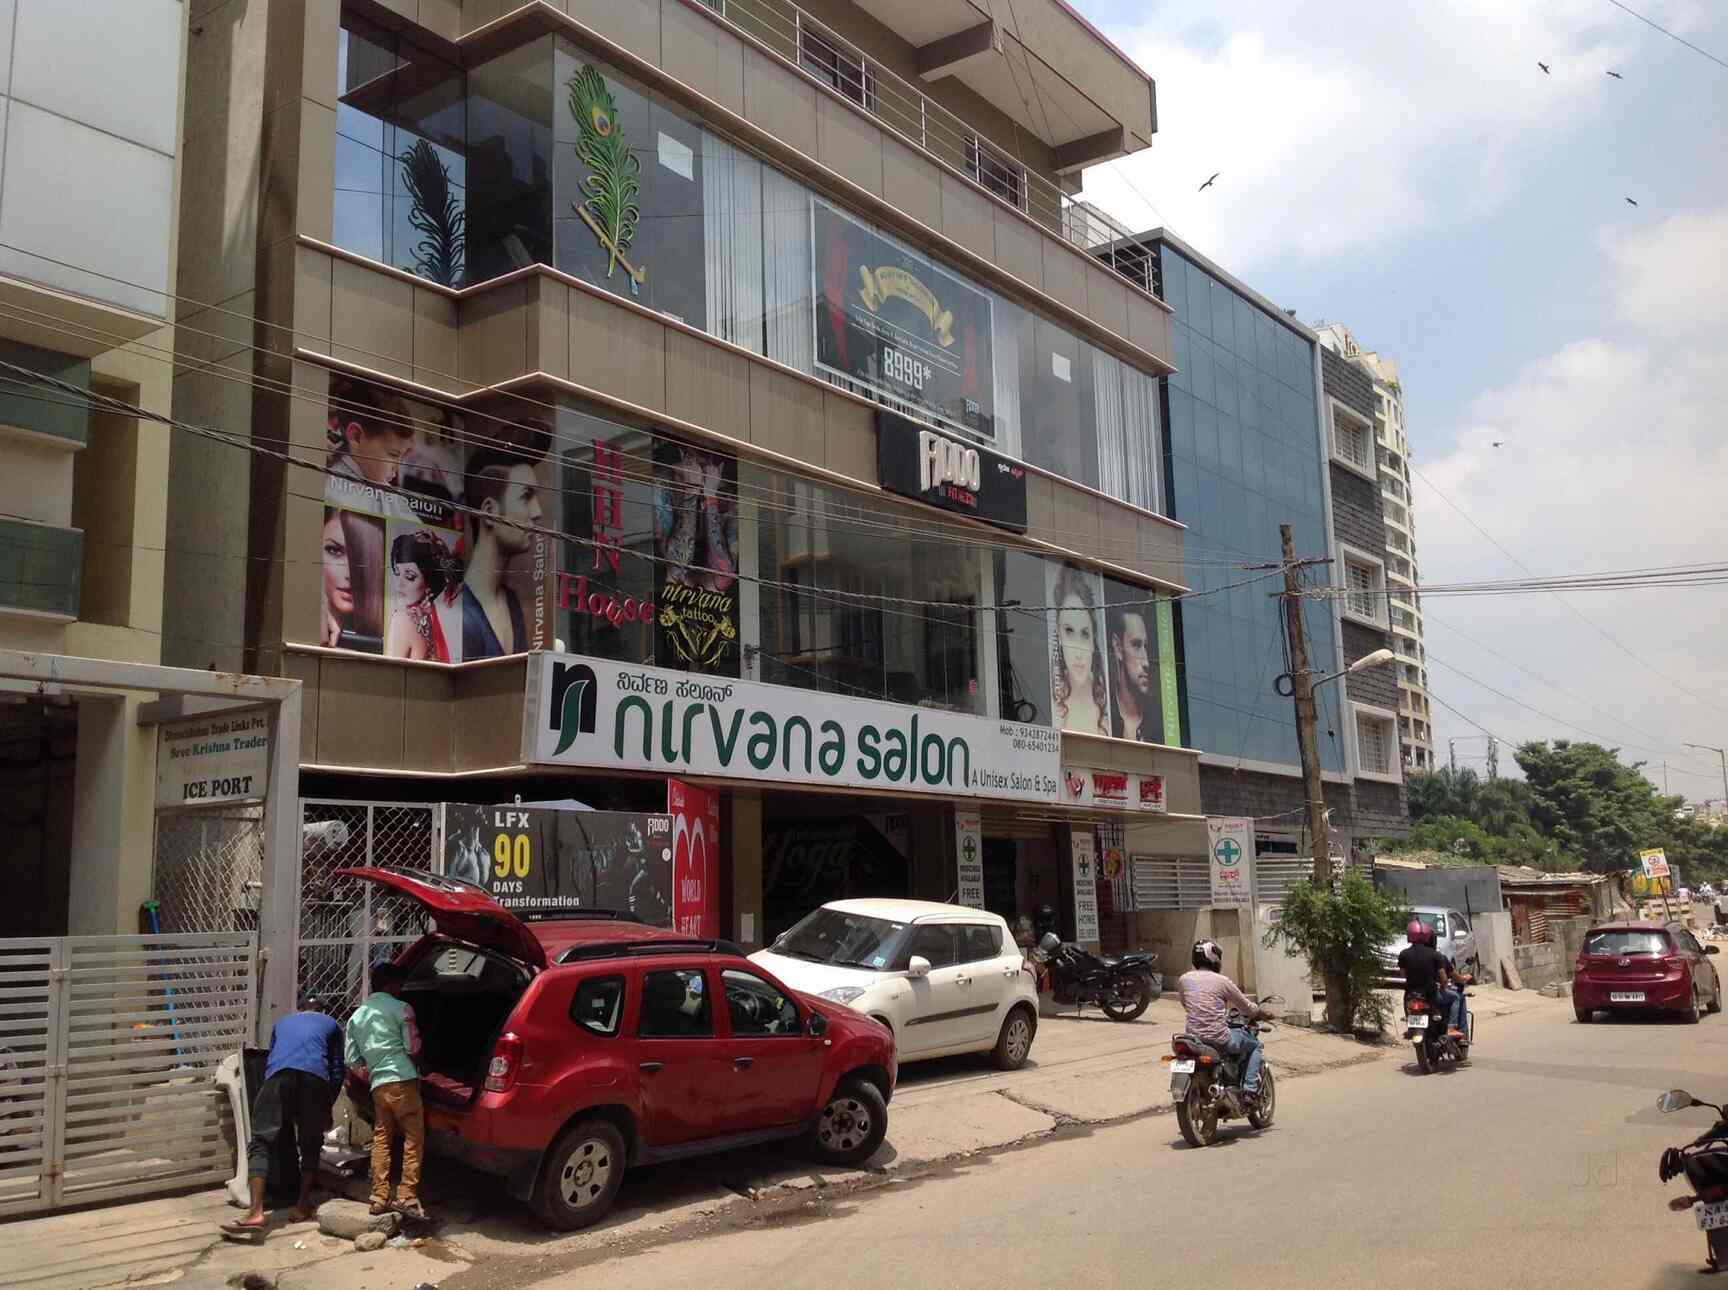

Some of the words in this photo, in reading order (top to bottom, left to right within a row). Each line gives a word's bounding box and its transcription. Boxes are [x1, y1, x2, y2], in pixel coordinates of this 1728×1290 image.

[614, 695, 846, 777] nirvana
[857, 713, 970, 788] salon
[183, 781, 208, 800] ICE
[211, 776, 253, 797] PORT
[980, 768, 1009, 789] Unisex
[1010, 772, 1033, 790] Salon
[1043, 776, 1057, 795] Spa
[494, 811, 530, 829] LFX
[494, 833, 531, 879] 90
[493, 881, 524, 894] DAYS
